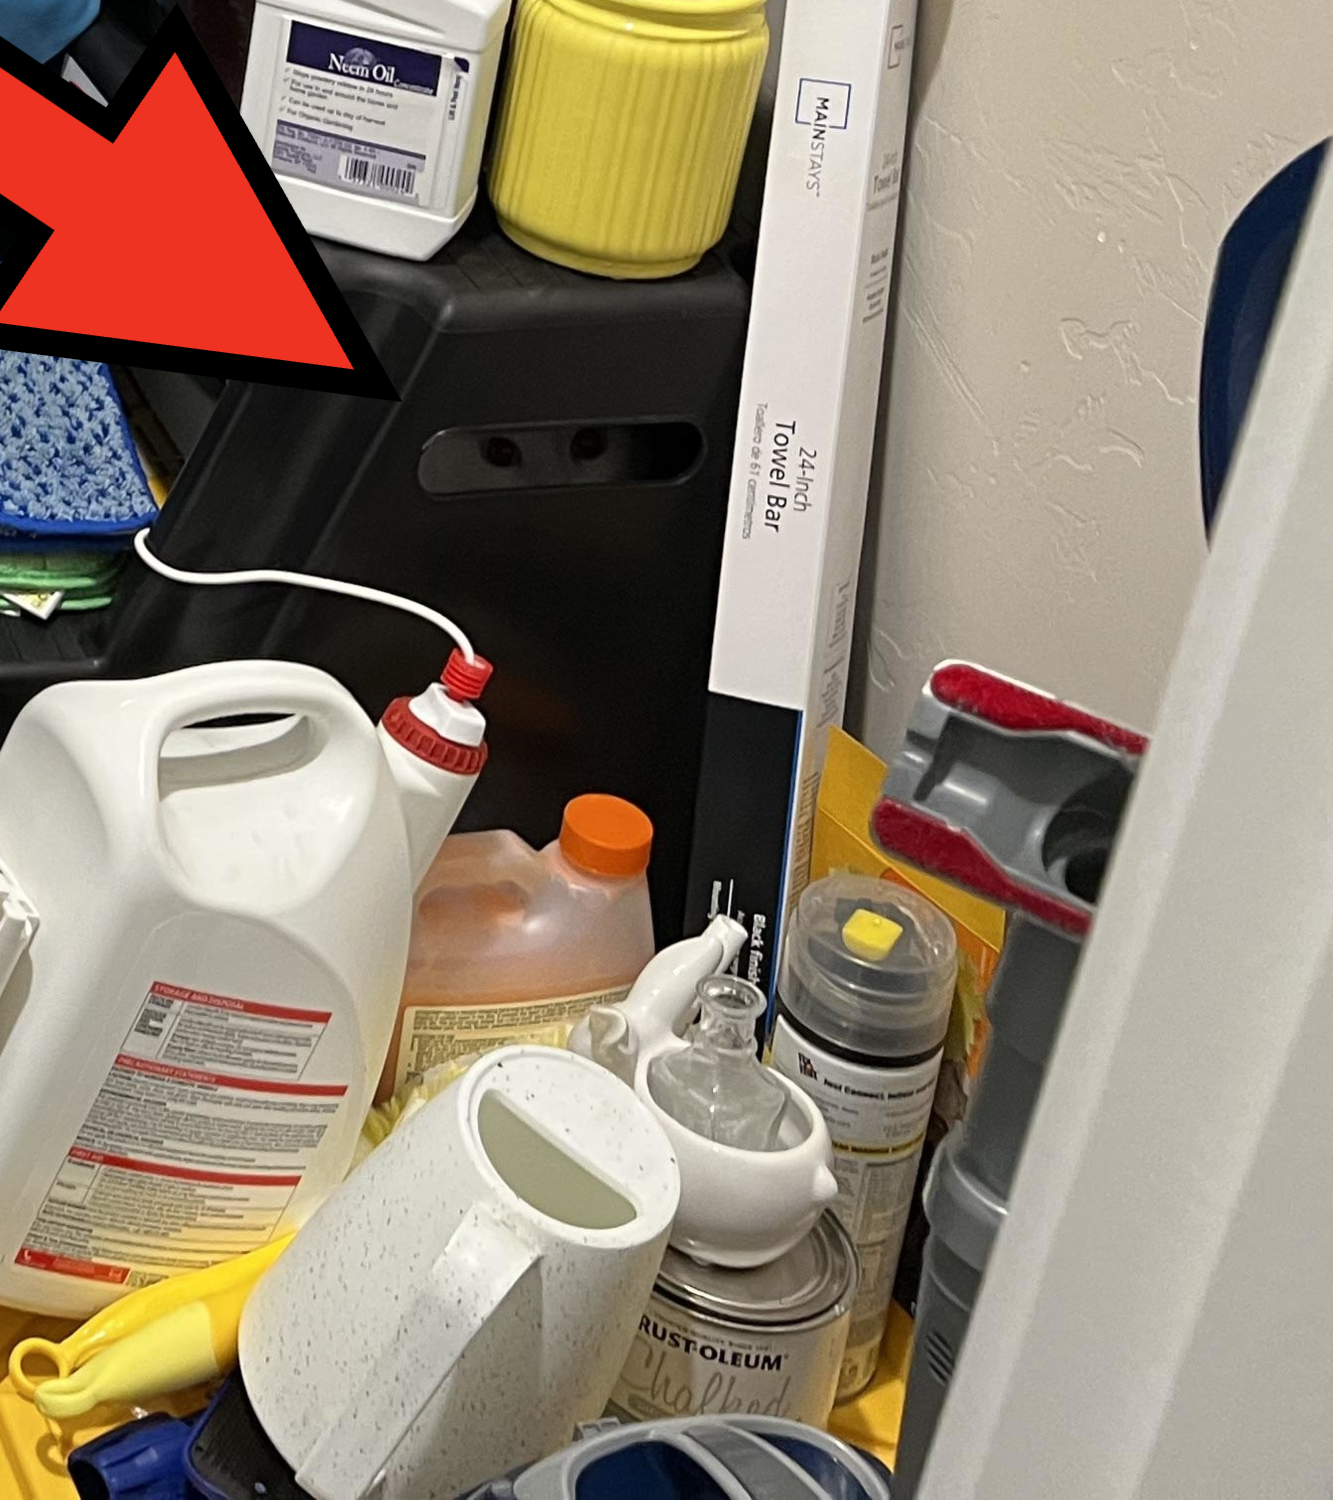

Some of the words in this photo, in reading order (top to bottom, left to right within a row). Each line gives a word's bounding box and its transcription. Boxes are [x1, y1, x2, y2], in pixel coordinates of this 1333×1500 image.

[327, 52, 370, 77] Neem
[372, 64, 396, 84] Oil
[807, 97, 830, 191] MAINSTAYS
[769, 421, 796, 488] Towel
[794, 447, 817, 512] 24-Inch
[764, 494, 787, 533] Bar
